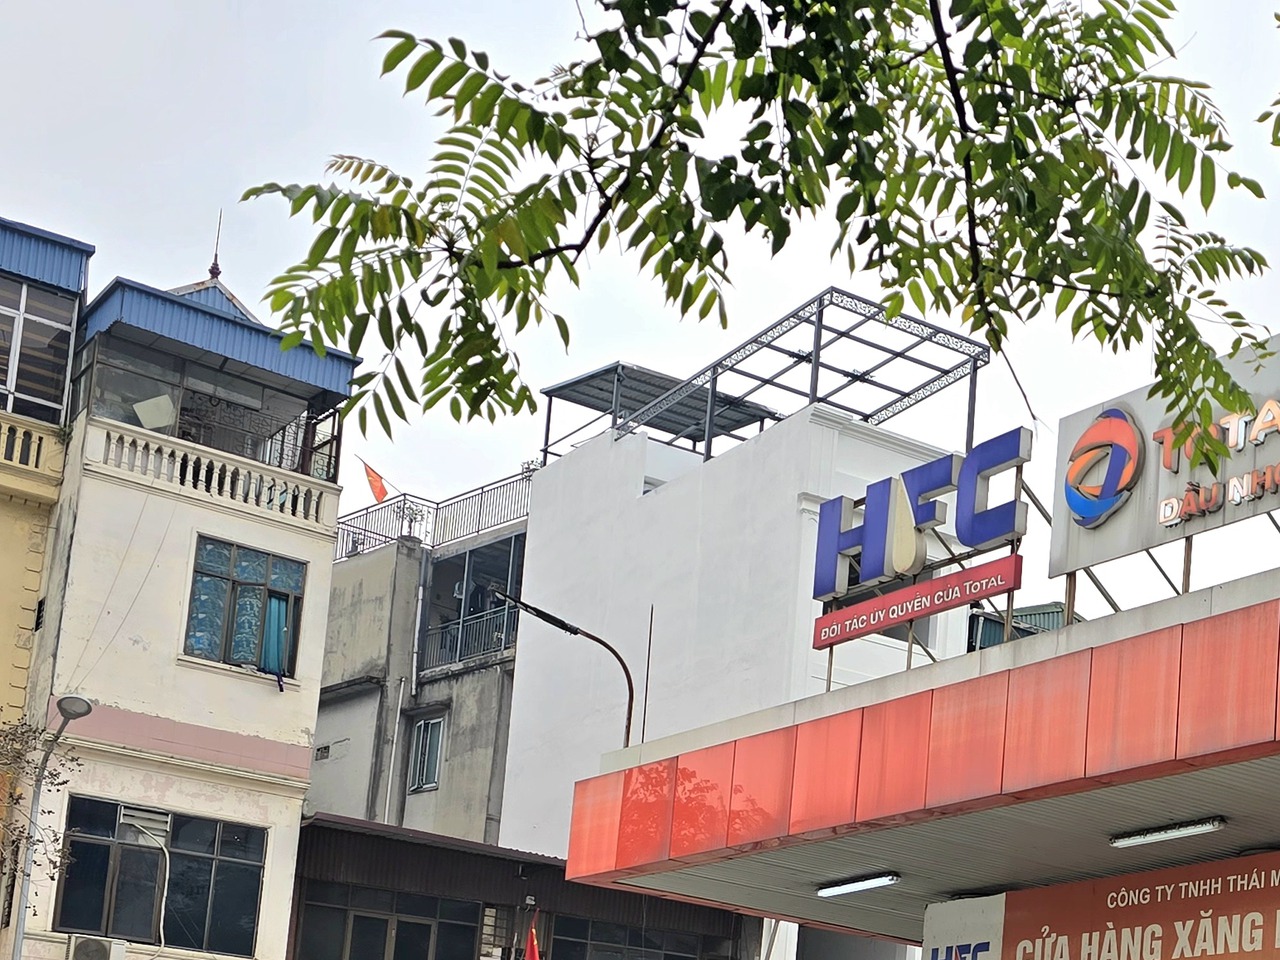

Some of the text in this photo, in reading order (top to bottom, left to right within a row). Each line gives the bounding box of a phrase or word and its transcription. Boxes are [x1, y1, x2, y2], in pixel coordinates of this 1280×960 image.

[814, 427, 1031, 600] HFC
[844, 614, 867, 633] TÁC
[889, 592, 931, 619] QUYỀN
[934, 584, 961, 604] CỦA
[1107, 886, 1150, 909] CÔNG
[1156, 885, 1175, 902] TY
[1179, 877, 1222, 899] TNHH
[1227, 869, 1265, 892] THÁI
[1171, 910, 1263, 960] XĂNG
